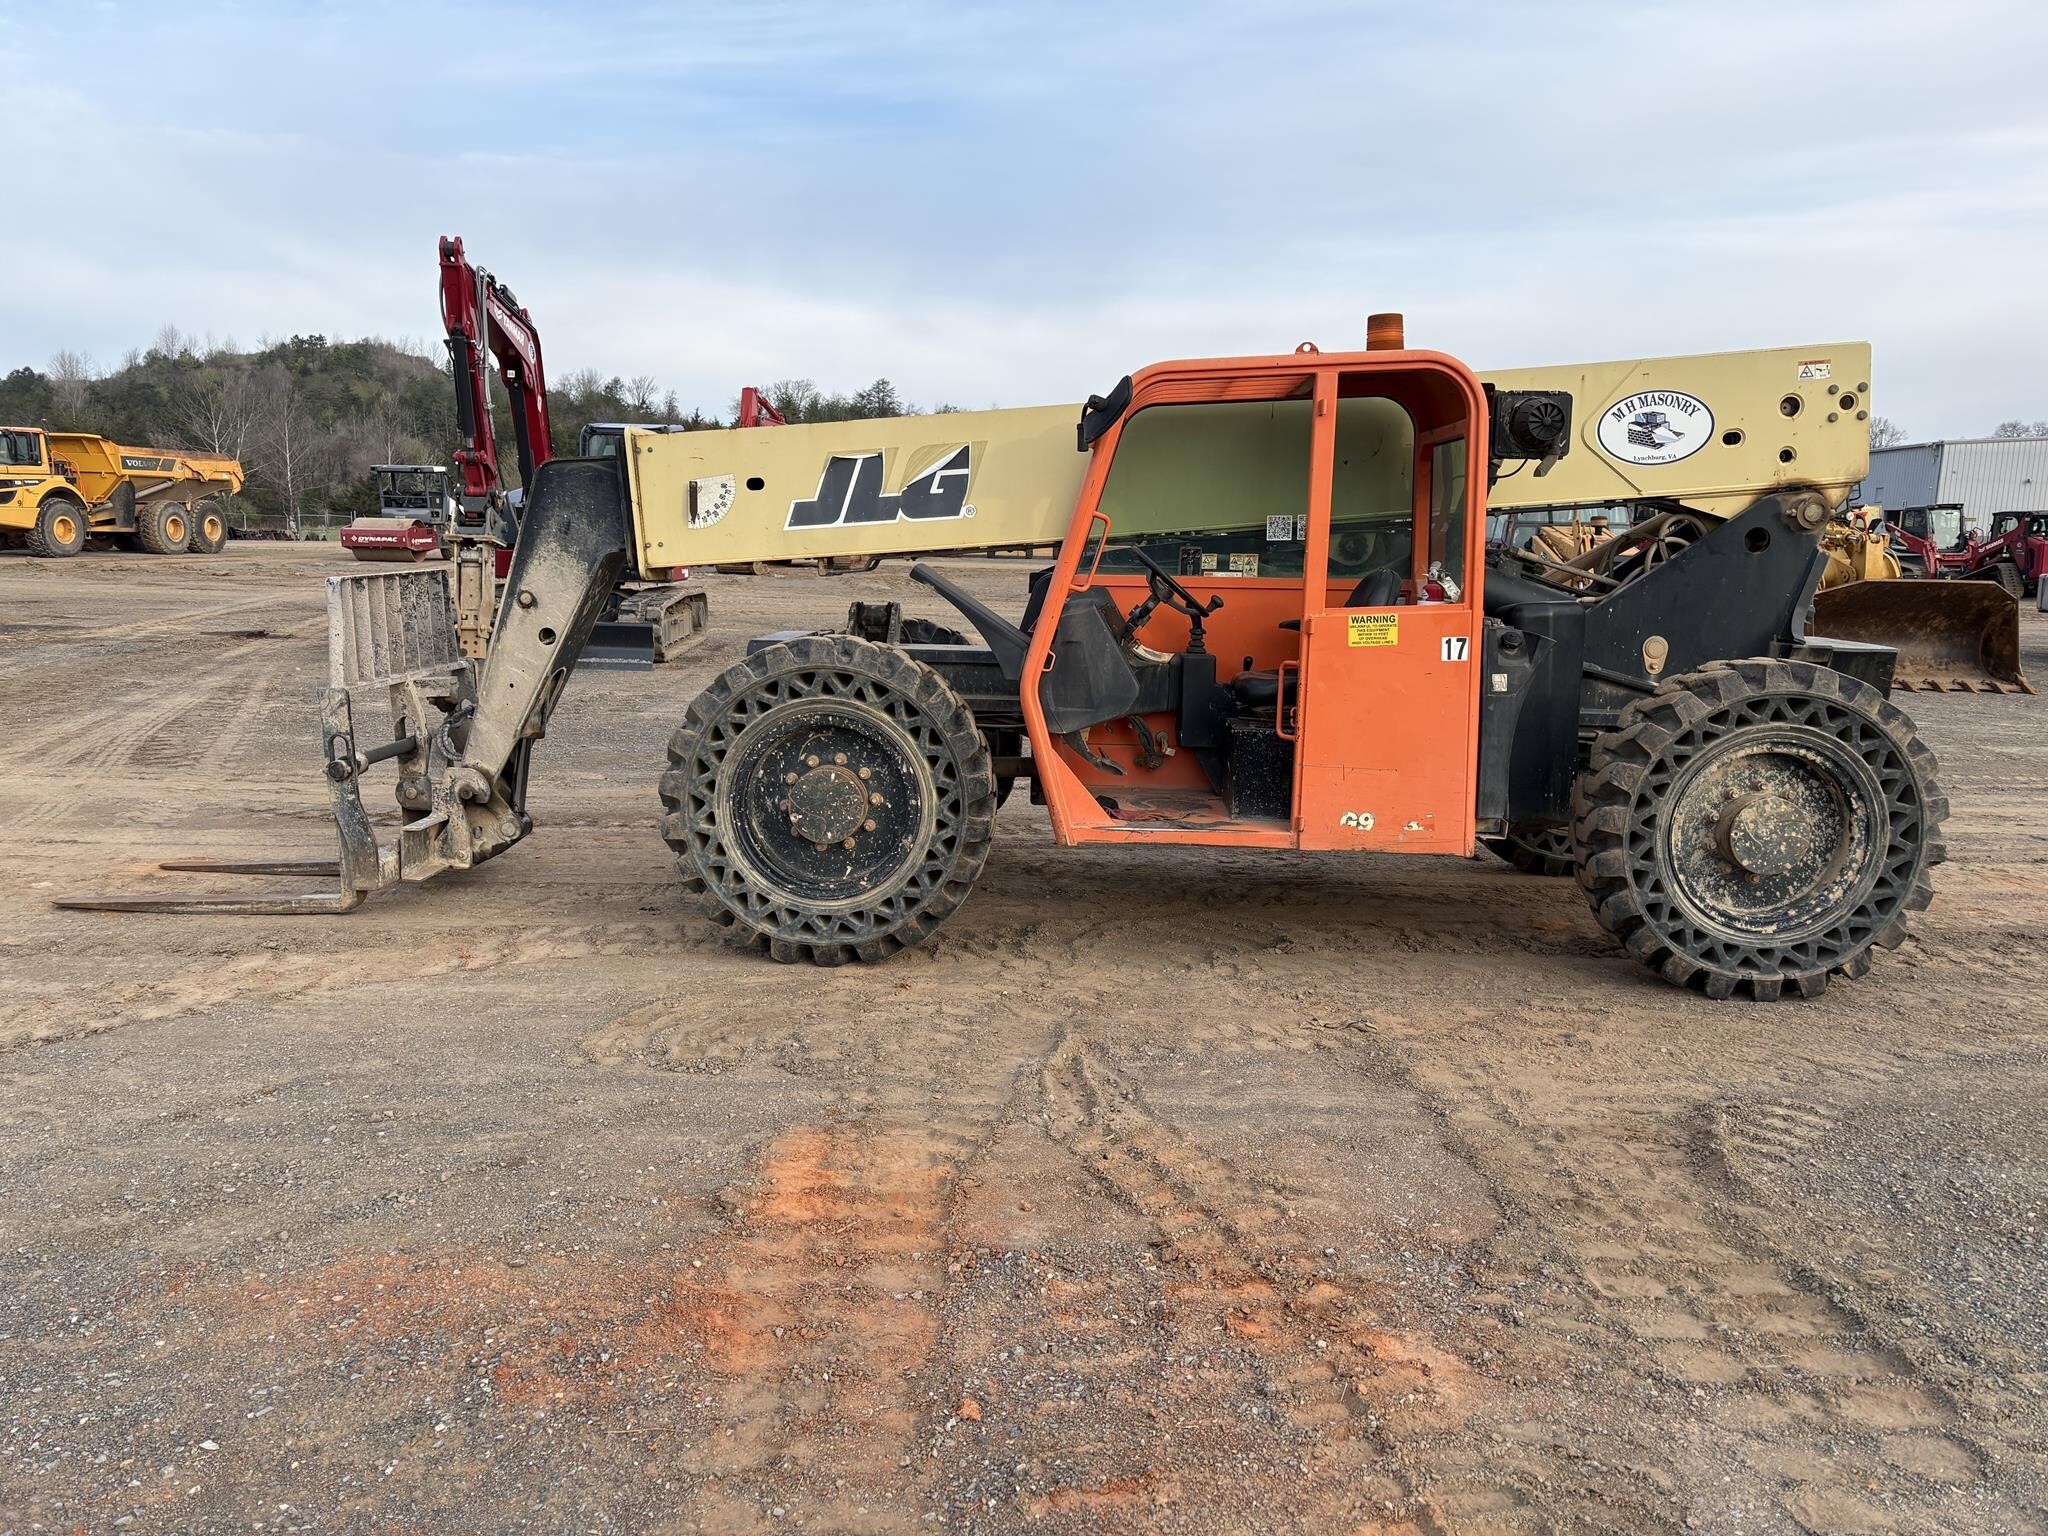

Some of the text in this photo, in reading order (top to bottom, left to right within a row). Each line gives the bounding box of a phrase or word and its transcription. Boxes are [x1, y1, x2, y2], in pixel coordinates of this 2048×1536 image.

[1611, 393, 1701, 423] M H MASONRY
[784, 441, 972, 531] JLG
[1351, 615, 1396, 624] WARNING
[1445, 637, 1467, 660] 17
